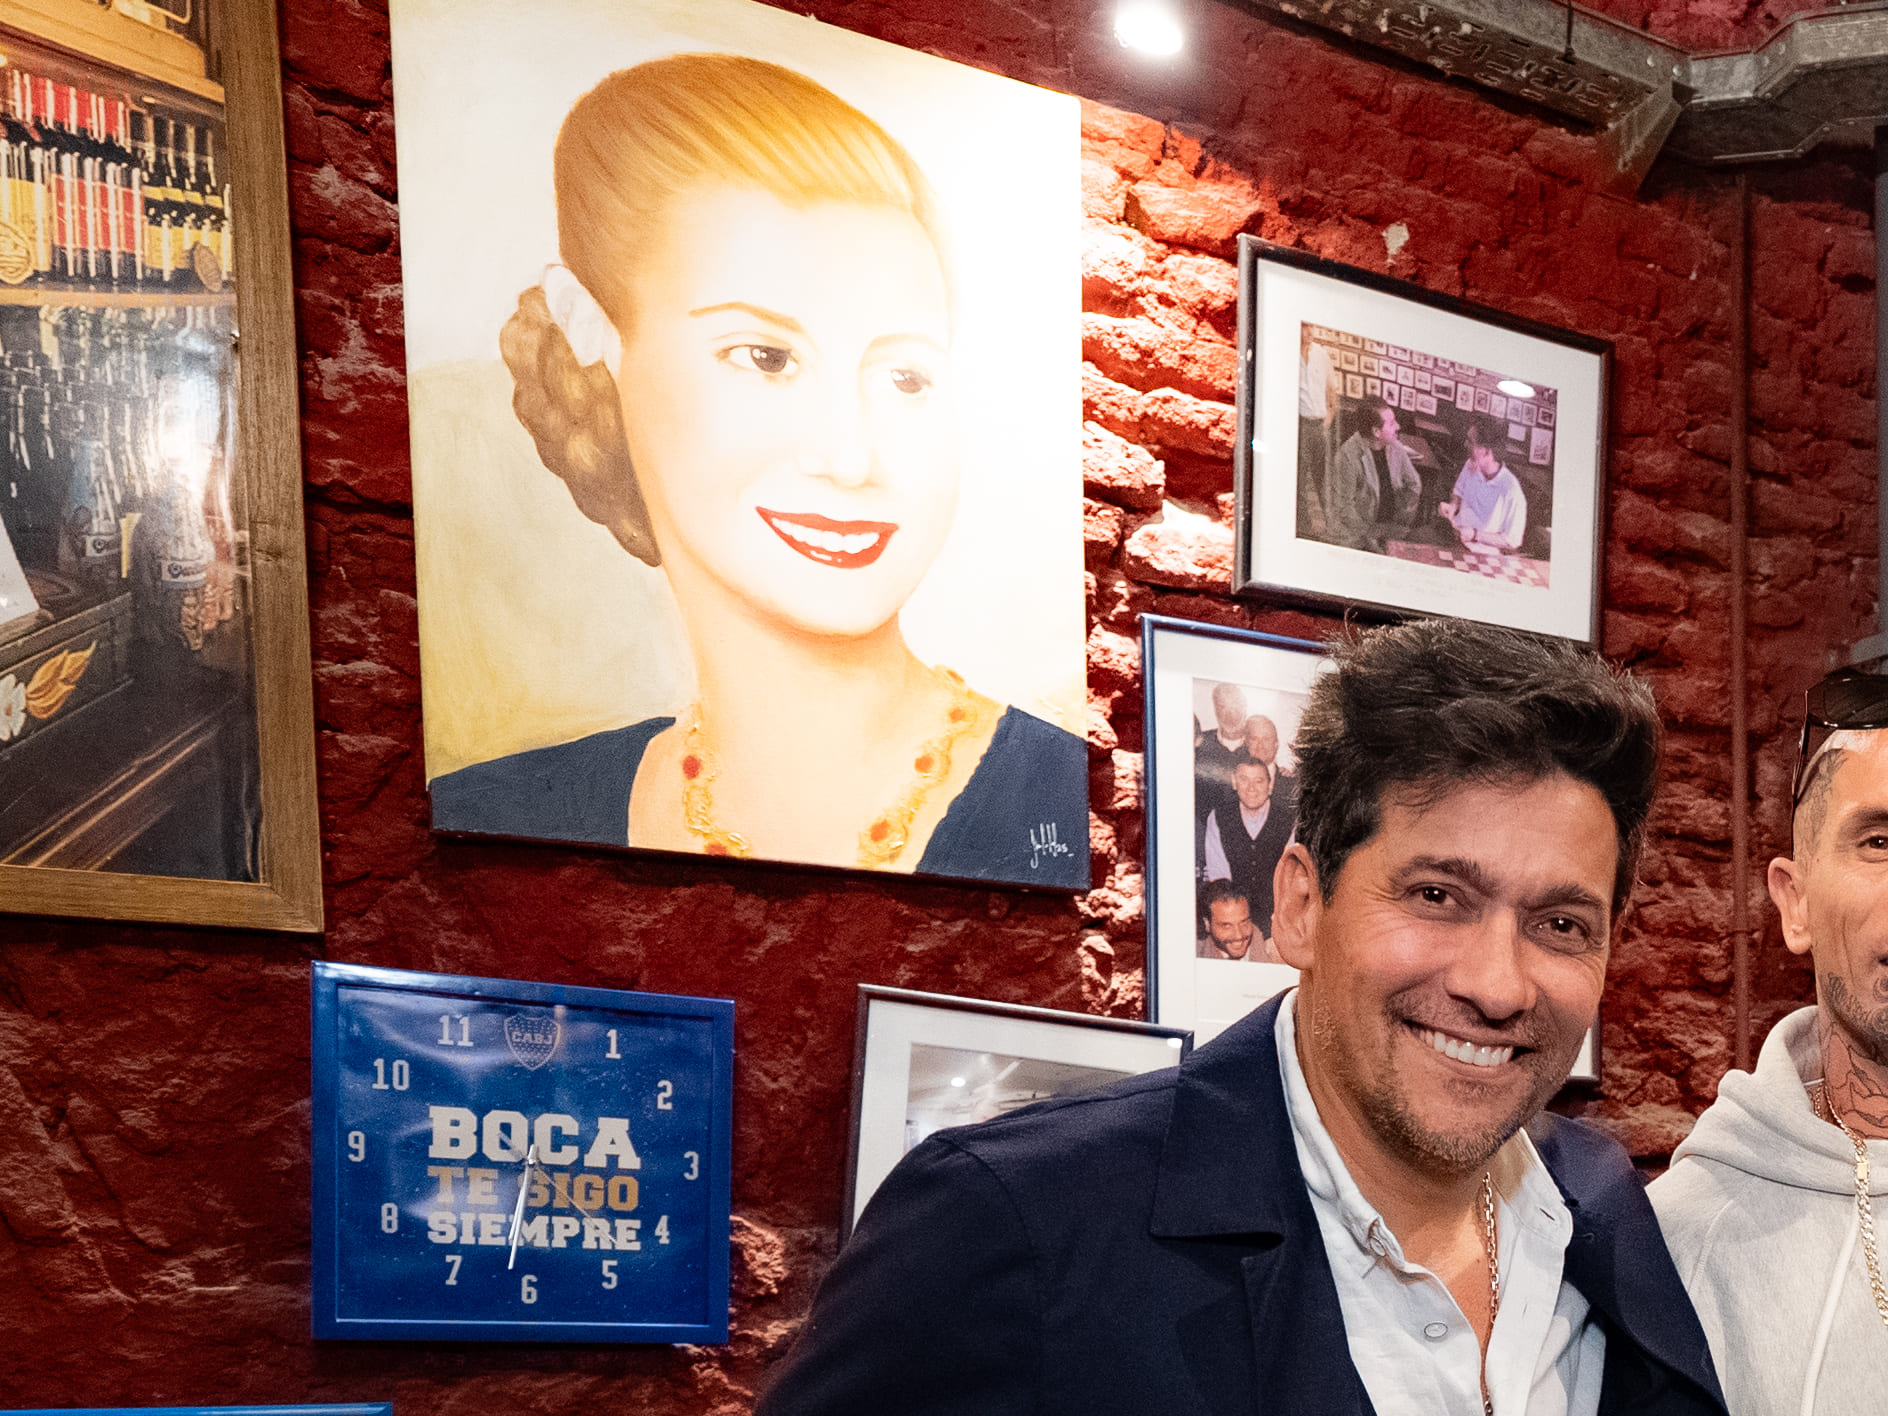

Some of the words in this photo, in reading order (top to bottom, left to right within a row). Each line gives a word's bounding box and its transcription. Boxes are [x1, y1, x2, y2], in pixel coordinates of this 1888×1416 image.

[437, 1015, 474, 1047] 11
[511, 1031, 553, 1045] CABJ
[605, 1029, 621, 1060] 1
[372, 1058, 410, 1091] 10
[656, 1080, 674, 1110] 2
[347, 1131, 366, 1162] 9
[428, 1106, 641, 1169] BOCA
[683, 1151, 699, 1180] 3
[427, 1166, 499, 1206] TE
[518, 1171, 640, 1212] SIGO
[381, 1203, 399, 1234] 8
[427, 1211, 642, 1251] SIEMPRE
[654, 1215, 671, 1245] 4
[444, 1255, 463, 1286] 7
[601, 1260, 619, 1290] 5
[521, 1275, 538, 1305] 6
